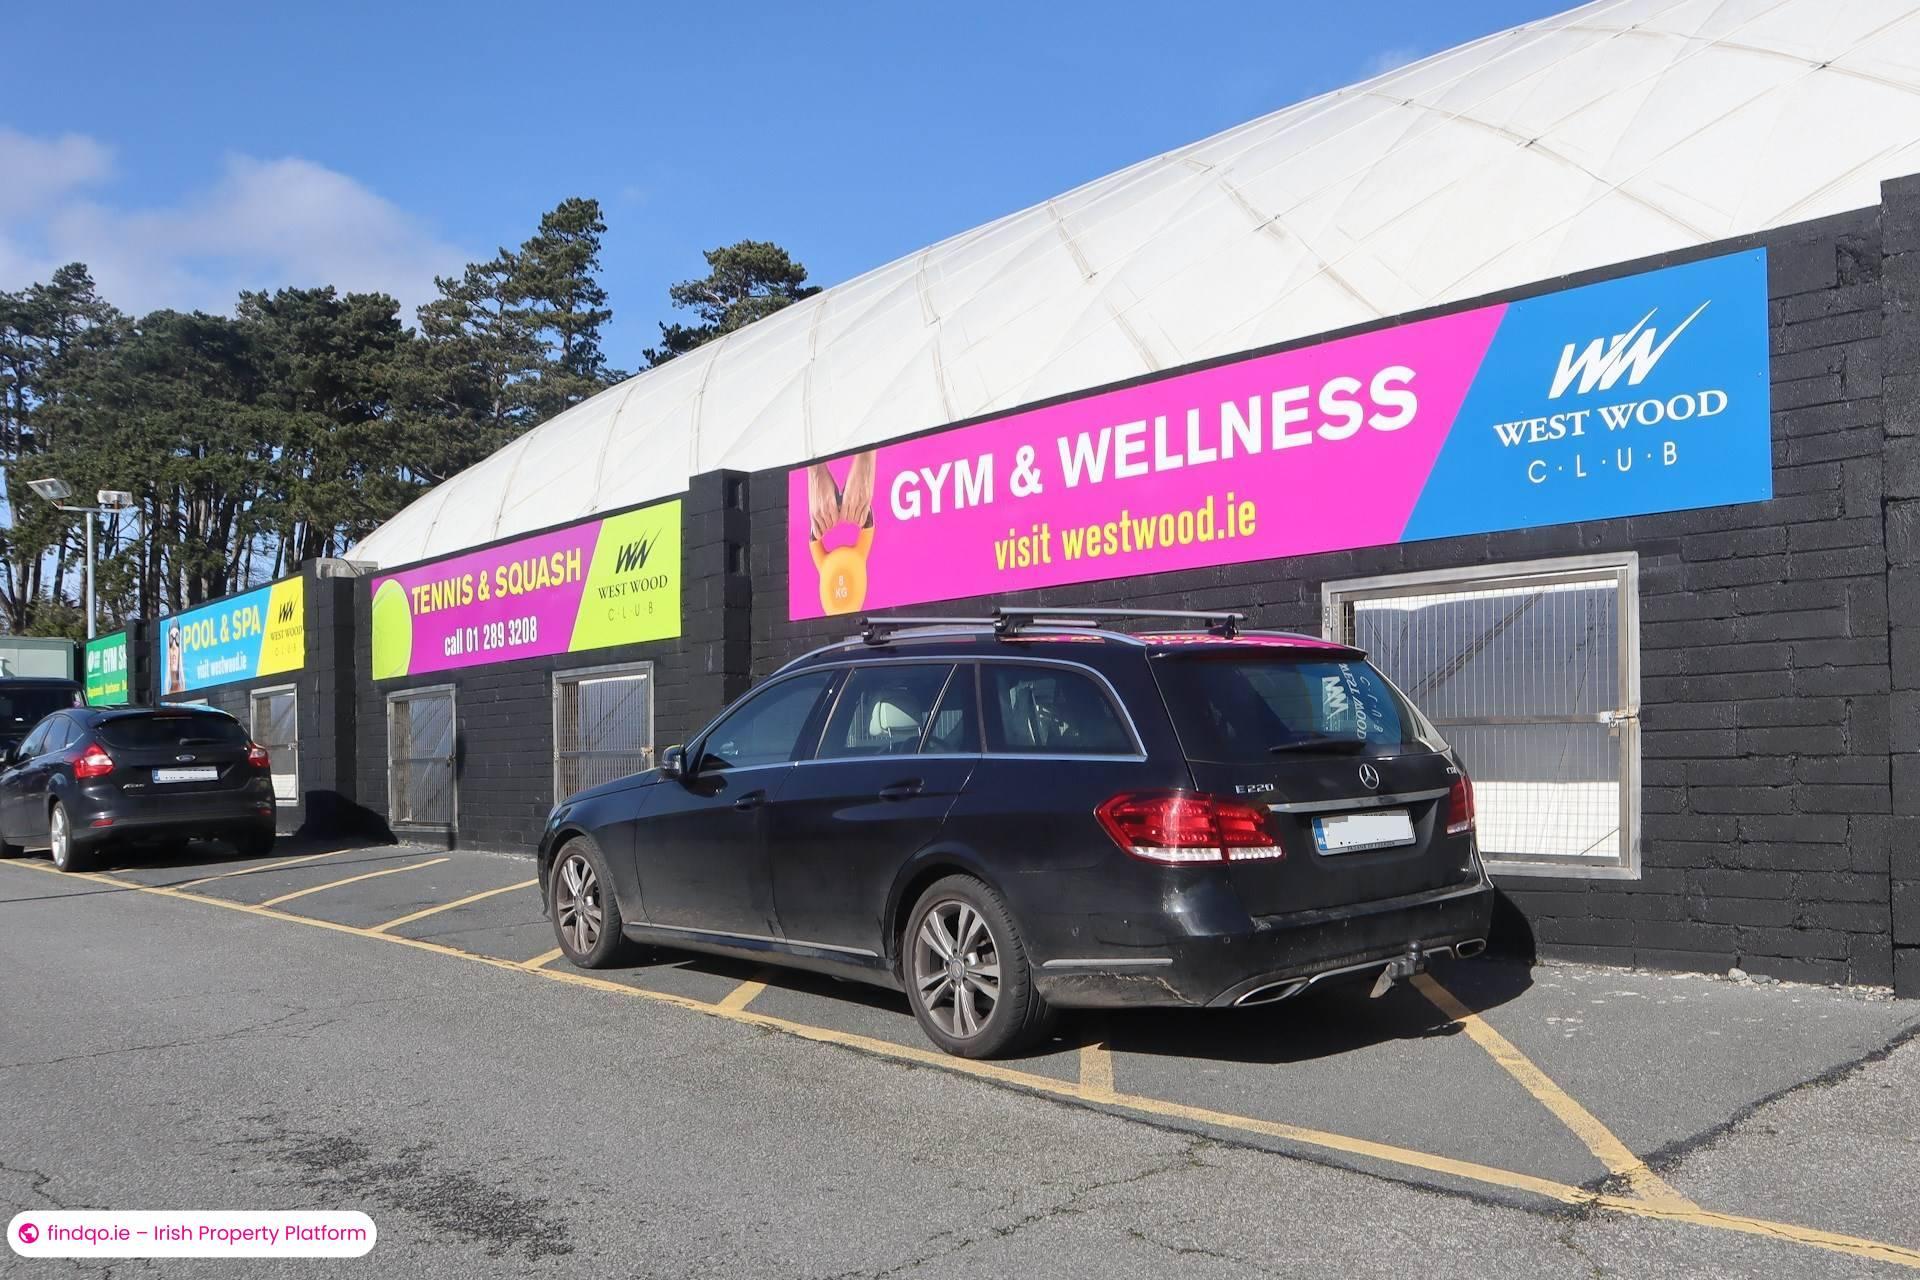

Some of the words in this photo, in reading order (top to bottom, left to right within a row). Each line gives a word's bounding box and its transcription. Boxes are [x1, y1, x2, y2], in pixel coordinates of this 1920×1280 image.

[890, 453, 994, 521] GYM
[1009, 444, 1044, 498] &
[1057, 364, 1419, 489] WELLNESS
[1493, 409, 1591, 448] WEST
[1597, 389, 1729, 432] WOOD
[994, 526, 1052, 571] visit
[1061, 491, 1257, 560] westwood.ie
[411, 573, 473, 615] TENNIS
[477, 570, 491, 601] &
[494, 548, 582, 599] SQUASH
[598, 582, 628, 600] WEST
[630, 574, 668, 593] WOOD
[835, 586, 848, 599] KG
[183, 617, 218, 653] POOL
[221, 613, 230, 643] &
[232, 604, 261, 640] SPA
[444, 627, 463, 657] call
[466, 625, 479, 653] 01
[483, 621, 505, 650] 289
[508, 615, 538, 647] 3208
